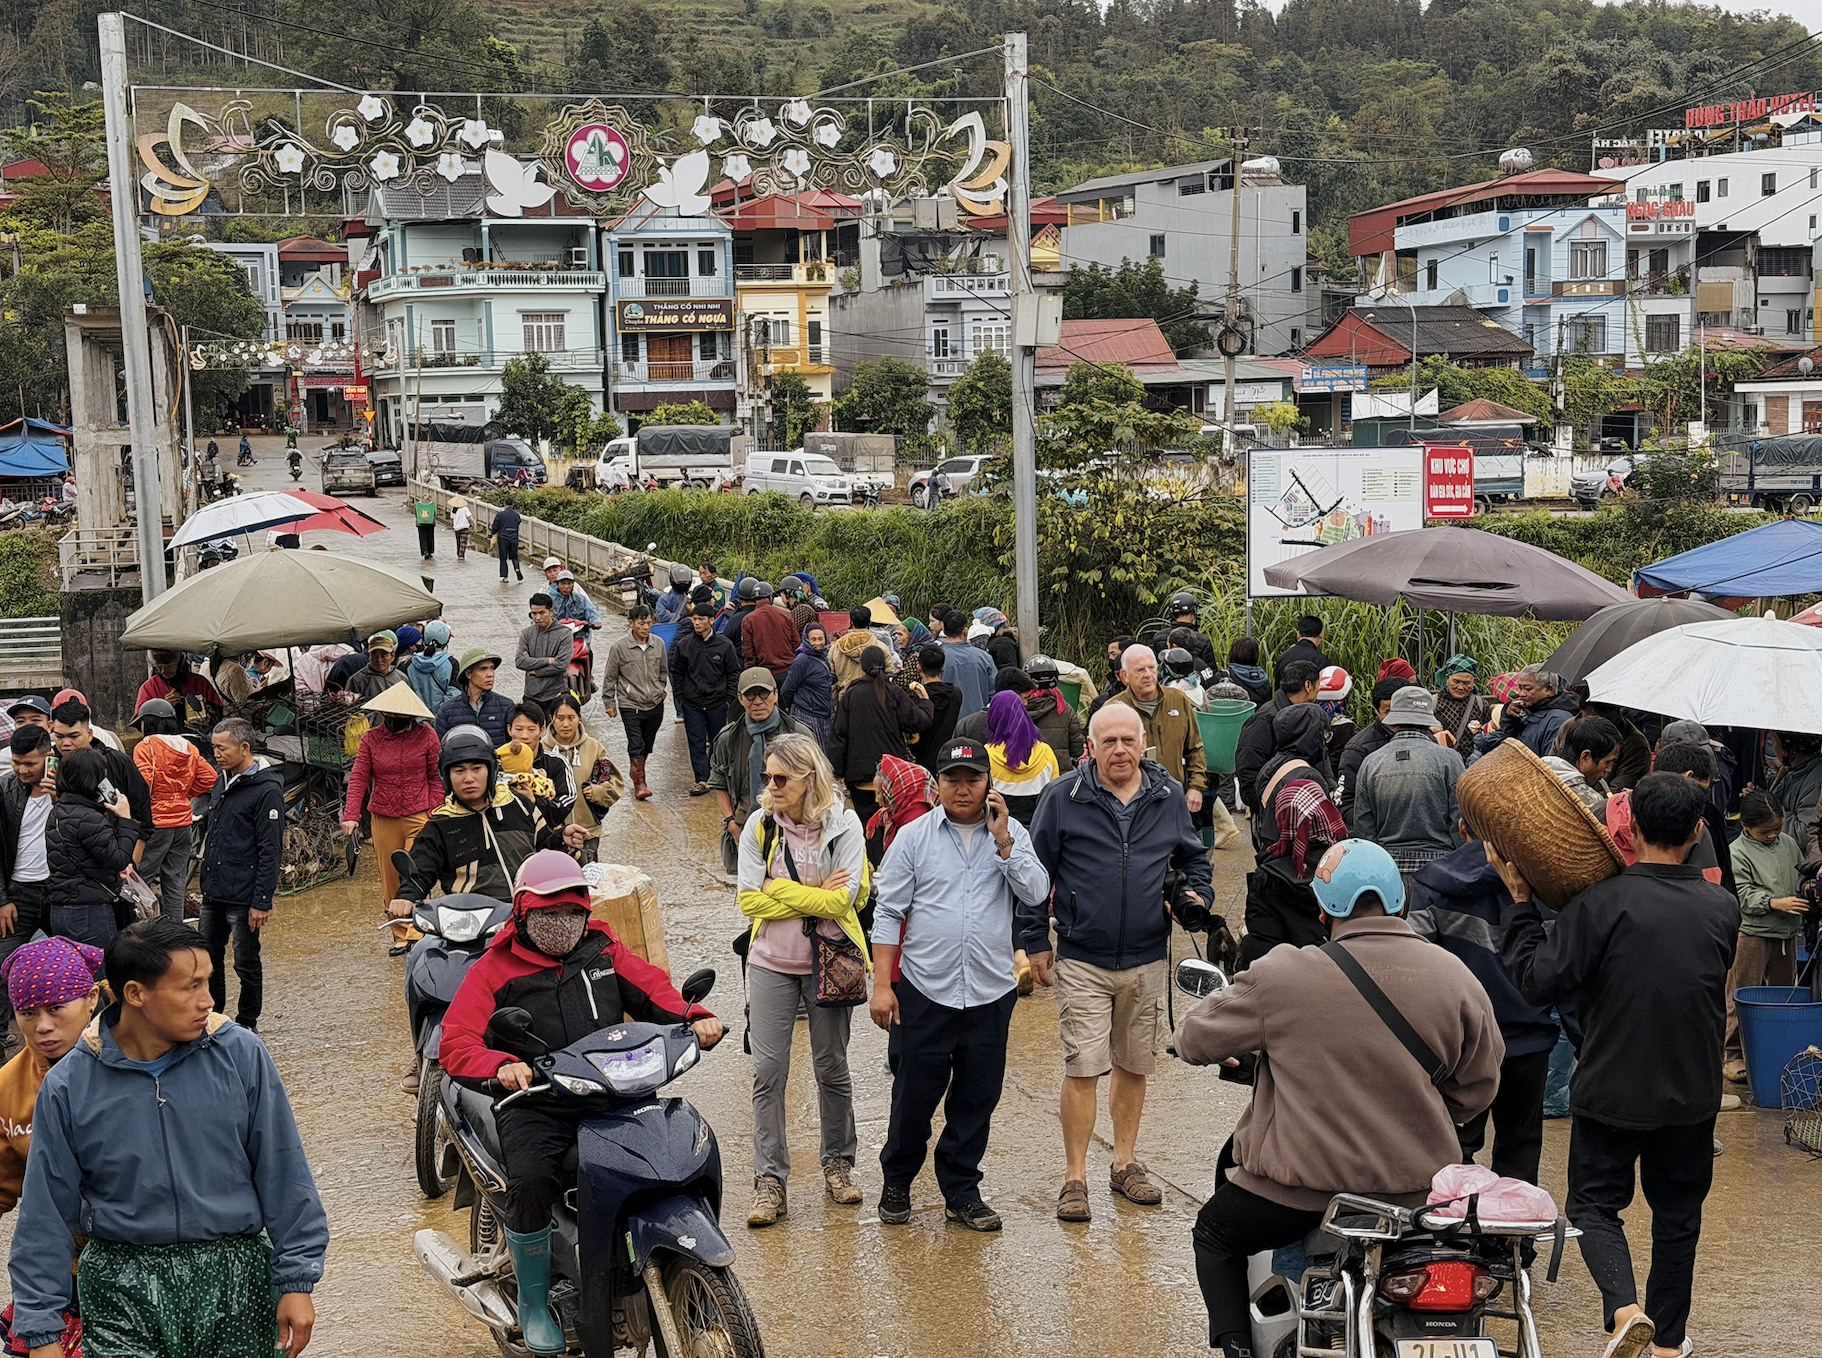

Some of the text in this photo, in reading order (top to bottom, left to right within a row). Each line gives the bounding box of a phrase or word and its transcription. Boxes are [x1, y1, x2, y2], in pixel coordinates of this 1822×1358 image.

[1770, 91, 1817, 116] HOTEL
[1627, 201, 1660, 221] NGỌC
[1663, 197, 1695, 217] CHÂU
[644, 311, 679, 325] THẮNG
[682, 311, 696, 324] CỐ
[698, 312, 727, 326] NGỰA
[1431, 456, 1470, 478] KHU VỰC CHỢ
[1430, 481, 1439, 498] BÁN
[1462, 480, 1471, 498] CẦM
[632, 1104, 663, 1116] HONDA
